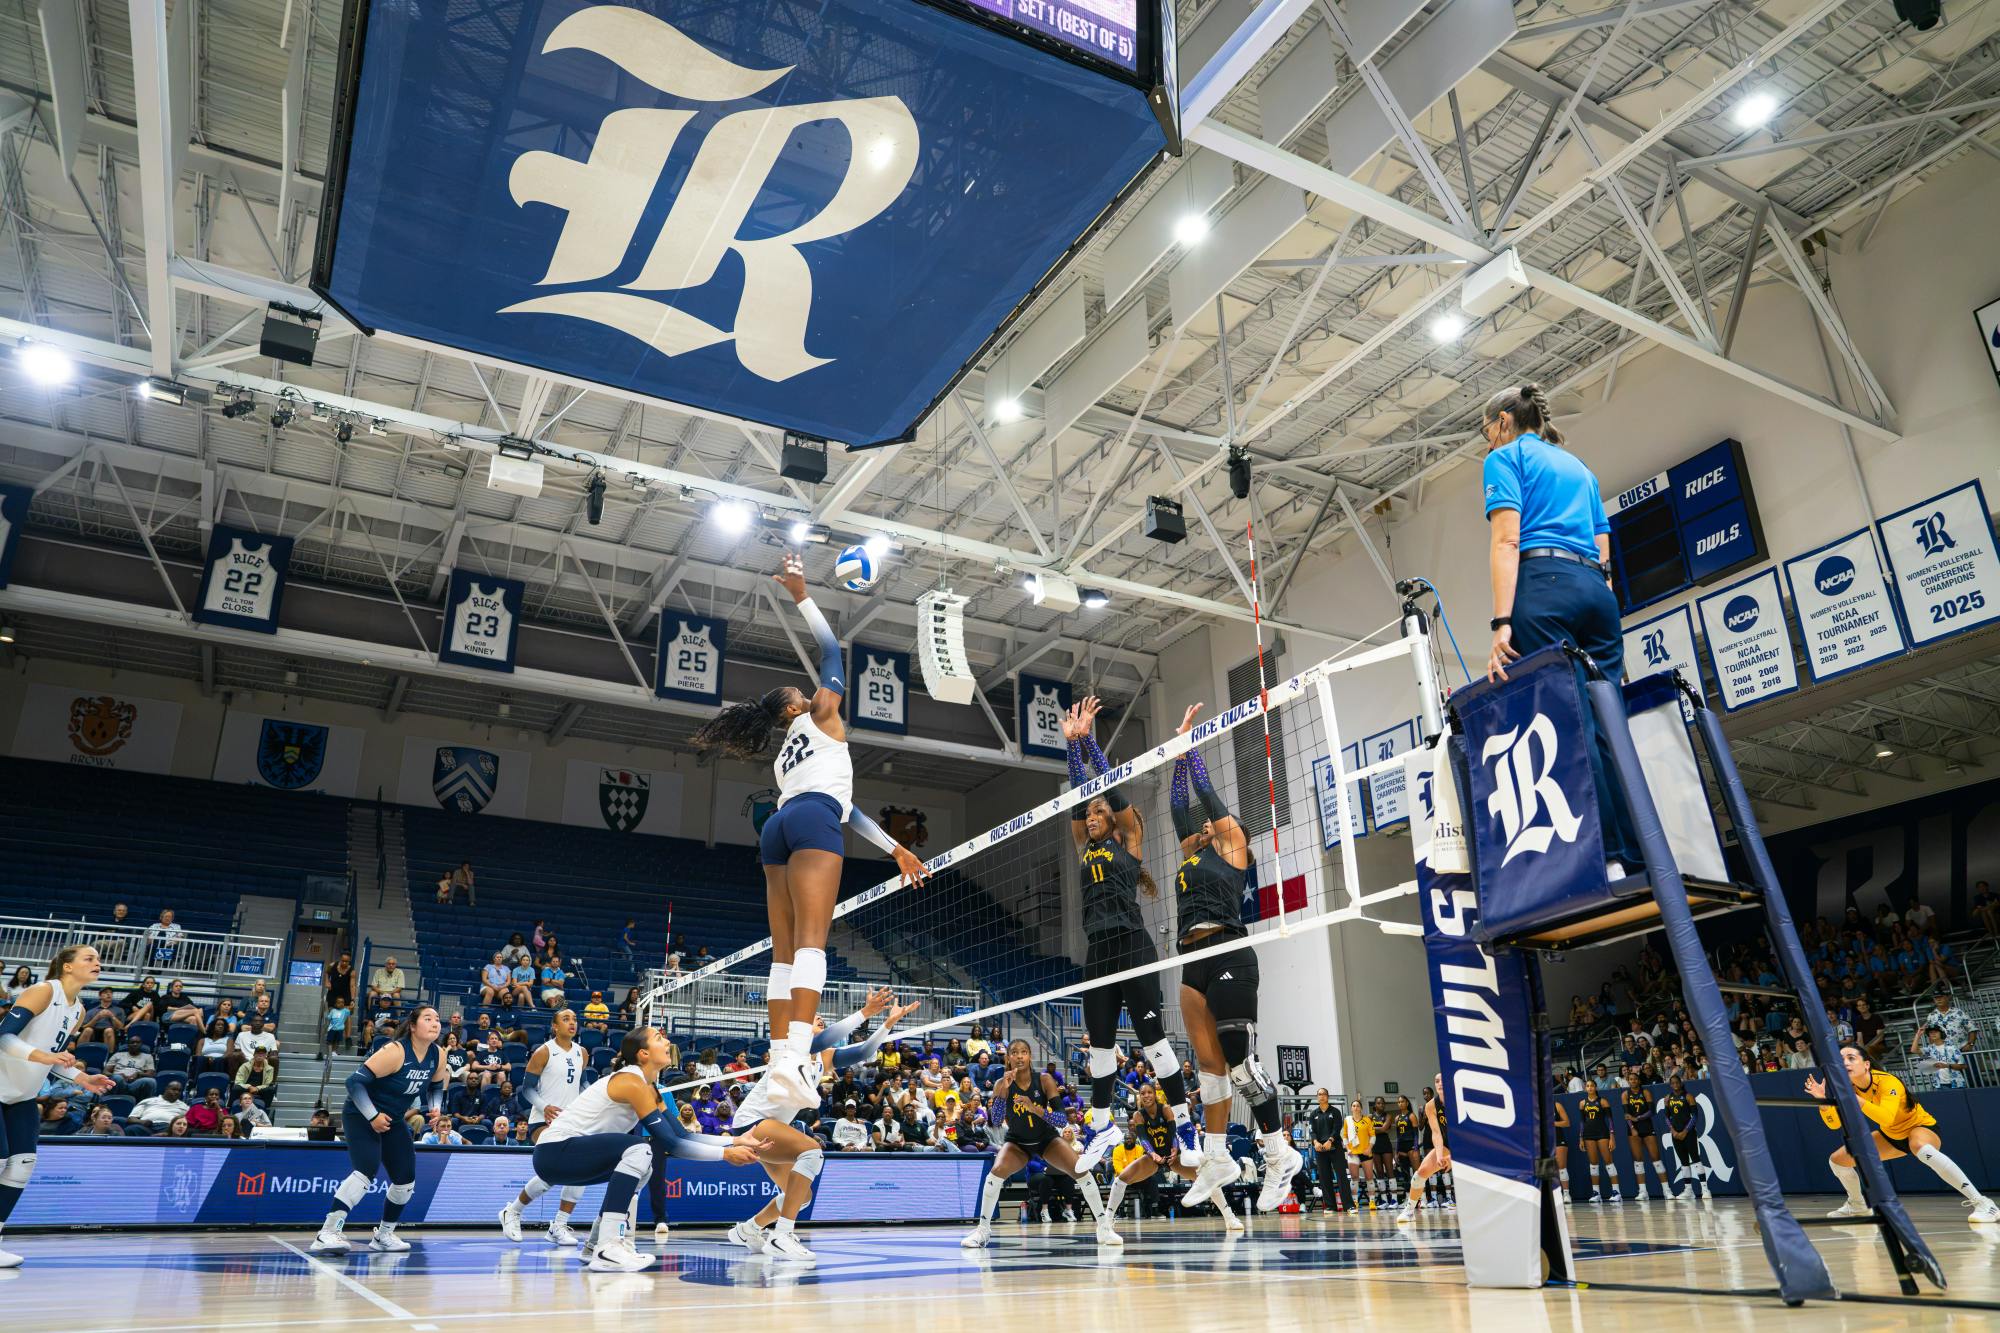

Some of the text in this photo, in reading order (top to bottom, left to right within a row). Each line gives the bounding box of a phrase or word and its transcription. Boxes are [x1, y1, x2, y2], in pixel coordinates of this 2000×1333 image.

[1018, 0, 1133, 62] SET 1 (BEST OF 5)
[1618, 477, 1658, 509] GUEST
[1685, 465, 1724, 499] RICE
[1696, 522, 1740, 556] OWLS
[232, 553, 265, 569] RICE
[1906, 548, 1983, 582] WOMEN'S VOLLEYBALL
[224, 568, 263, 596] 22
[1820, 568, 1856, 591] NCAA
[1920, 561, 1976, 588] CONFERENCE
[1925, 571, 1976, 596] CHAMPIONS
[221, 602, 254, 614] CLOSS
[224, 596, 239, 604] BILL
[472, 597, 500, 611] RICE
[1809, 590, 1877, 620] WOMEN'S VOLLEYBALL
[1930, 589, 1986, 624] 2025
[466, 612, 499, 637] 23
[1728, 607, 1760, 628] NCAA
[1817, 610, 1880, 641] TOURNAMENT
[1832, 607, 1859, 624] NCAA
[464, 644, 495, 656] KINNEY
[681, 635, 707, 648] RICE
[1718, 627, 1778, 654] WOMEN'S VOLLEYBALL
[1738, 643, 1762, 659] NCAA
[1818, 643, 1838, 655] 2019
[1843, 634, 1862, 646] 2021
[678, 649, 708, 672] 25
[1724, 647, 1781, 675] TOURNAMENT
[1820, 644, 1865, 665] 2020 2022
[677, 679, 705, 690] PIERCE
[870, 667, 893, 681] RICE
[869, 681, 895, 704] 29
[1036, 696, 1057, 709] RICE
[870, 709, 893, 720] LANCE
[1037, 710, 1059, 732] 32
[1191, 697, 1258, 744] RICE OWLS
[69, 754, 115, 767] BROWN
[782, 733, 814, 777] 22
[1080, 761, 1133, 800] RICE OWLS
[1482, 712, 1584, 869] R
[990, 811, 1034, 843] RICE OWLS
[933, 850, 953, 870] OWLS
[1091, 864, 1104, 883] 11
[1430, 888, 1516, 1129] OWLS
[406, 1069, 430, 1080] RICE
[566, 1068, 576, 1084] 5
[403, 1081, 424, 1095] 16
[1673, 1106, 1679, 1114] 6
[1153, 1136, 1166, 1148] 12
